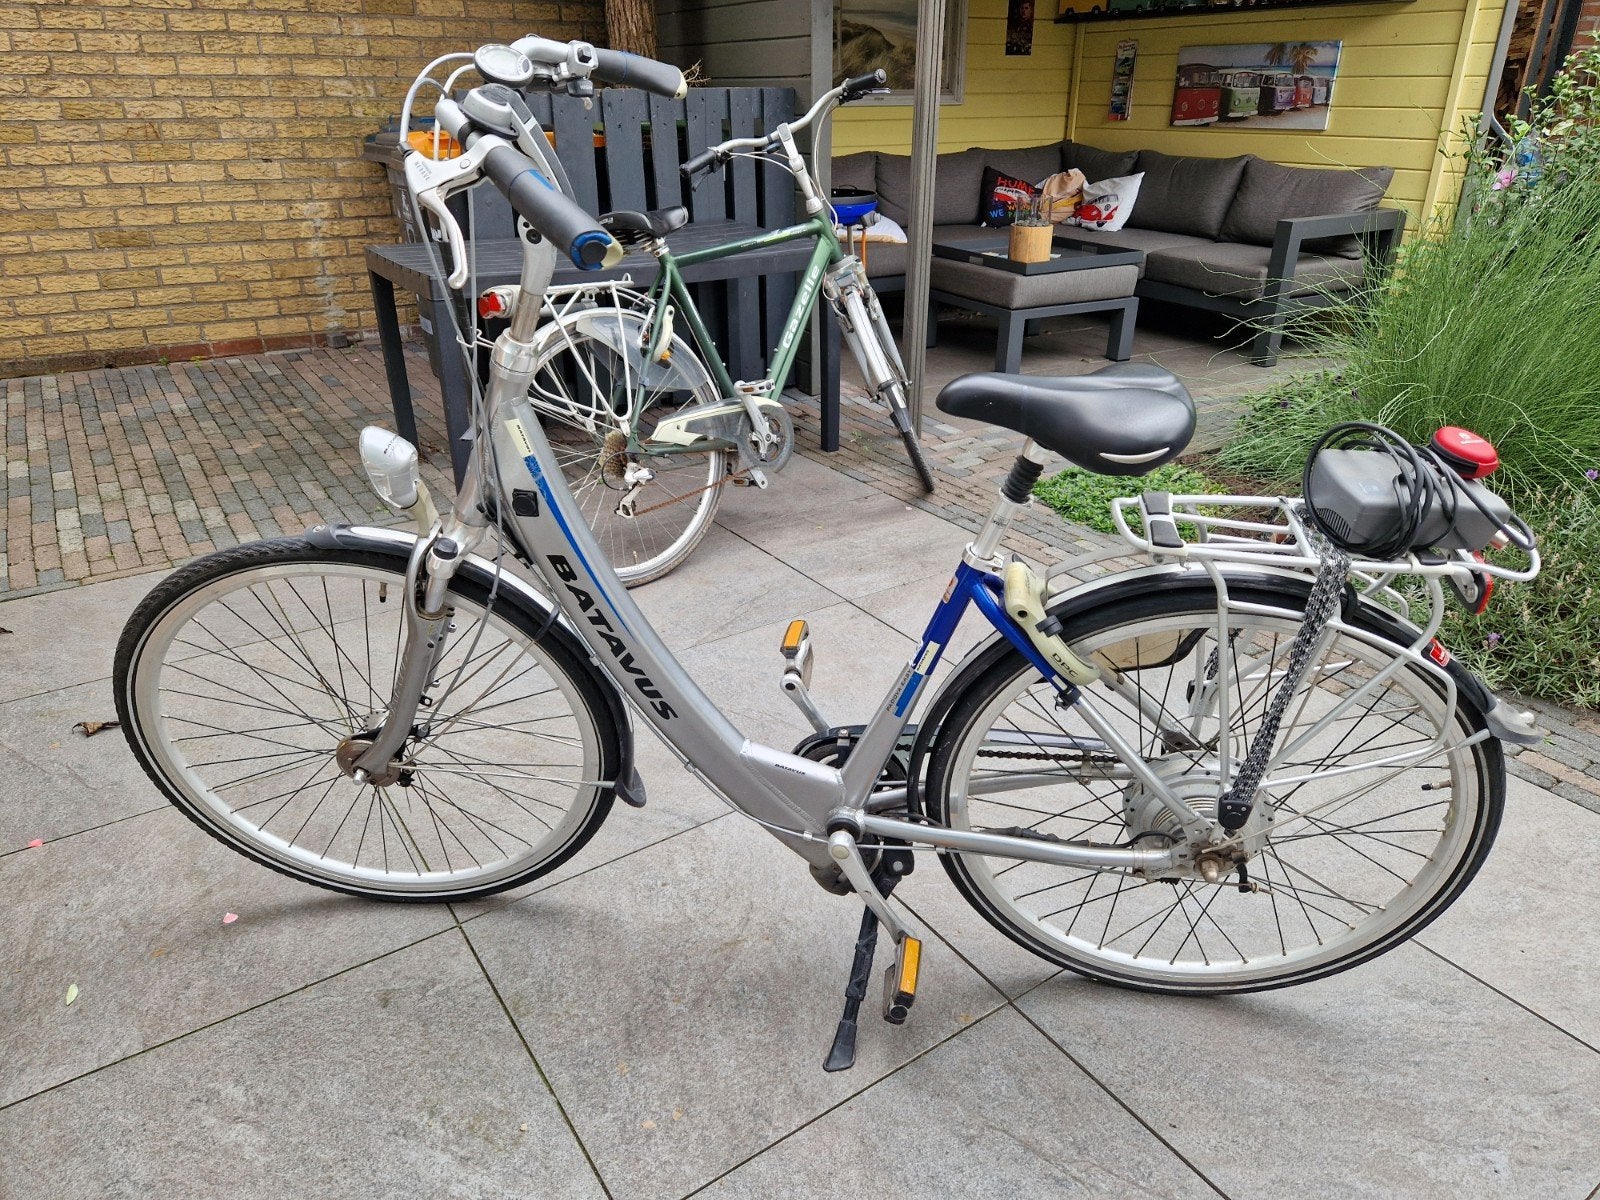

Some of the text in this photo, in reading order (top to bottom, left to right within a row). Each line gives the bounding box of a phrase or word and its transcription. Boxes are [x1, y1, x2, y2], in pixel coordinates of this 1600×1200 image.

[989, 208, 1005, 218] WE
[783, 265, 820, 349] Gazelle
[546, 555, 679, 720] BATAVUS
